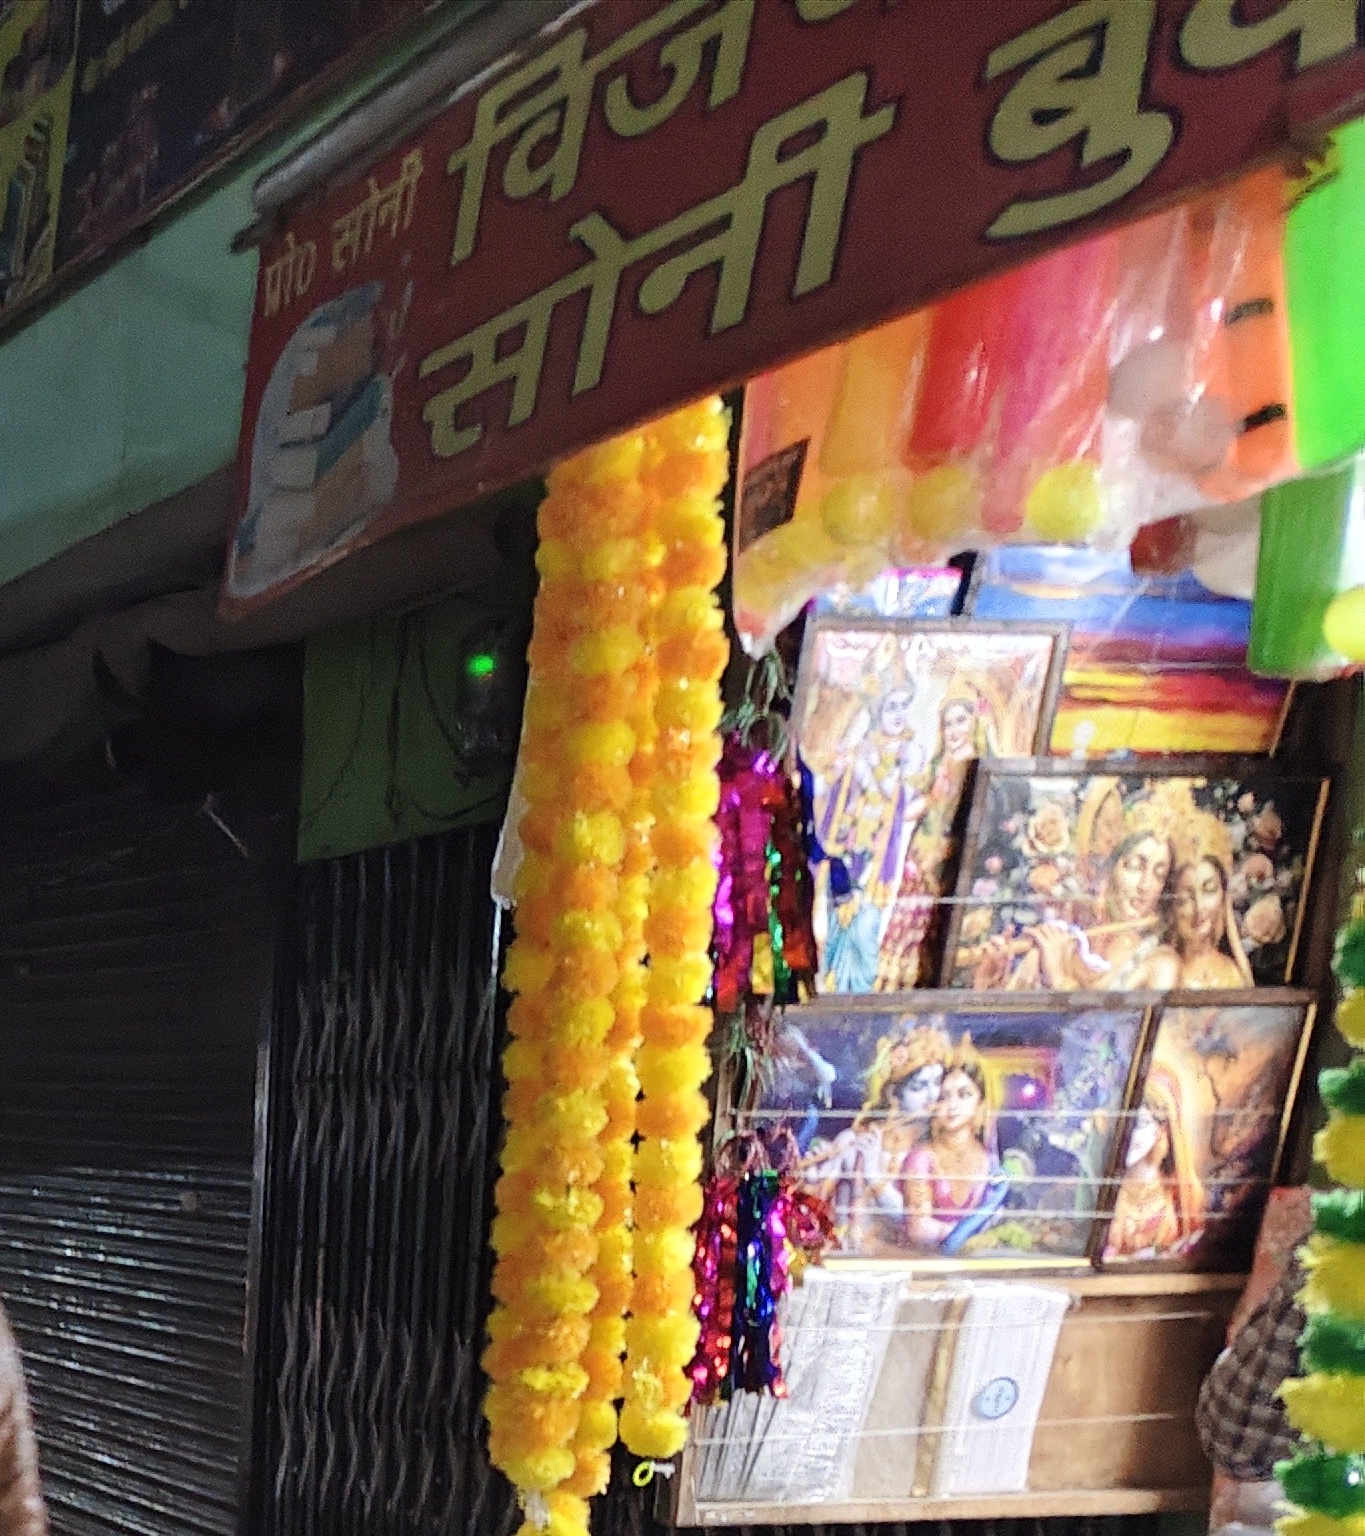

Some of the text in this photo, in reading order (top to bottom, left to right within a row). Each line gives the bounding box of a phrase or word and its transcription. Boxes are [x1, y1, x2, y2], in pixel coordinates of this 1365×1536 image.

[330, 148, 424, 273] सोनी
[418, 71, 897, 458] सोनी
[448, 0, 857, 266] विज
